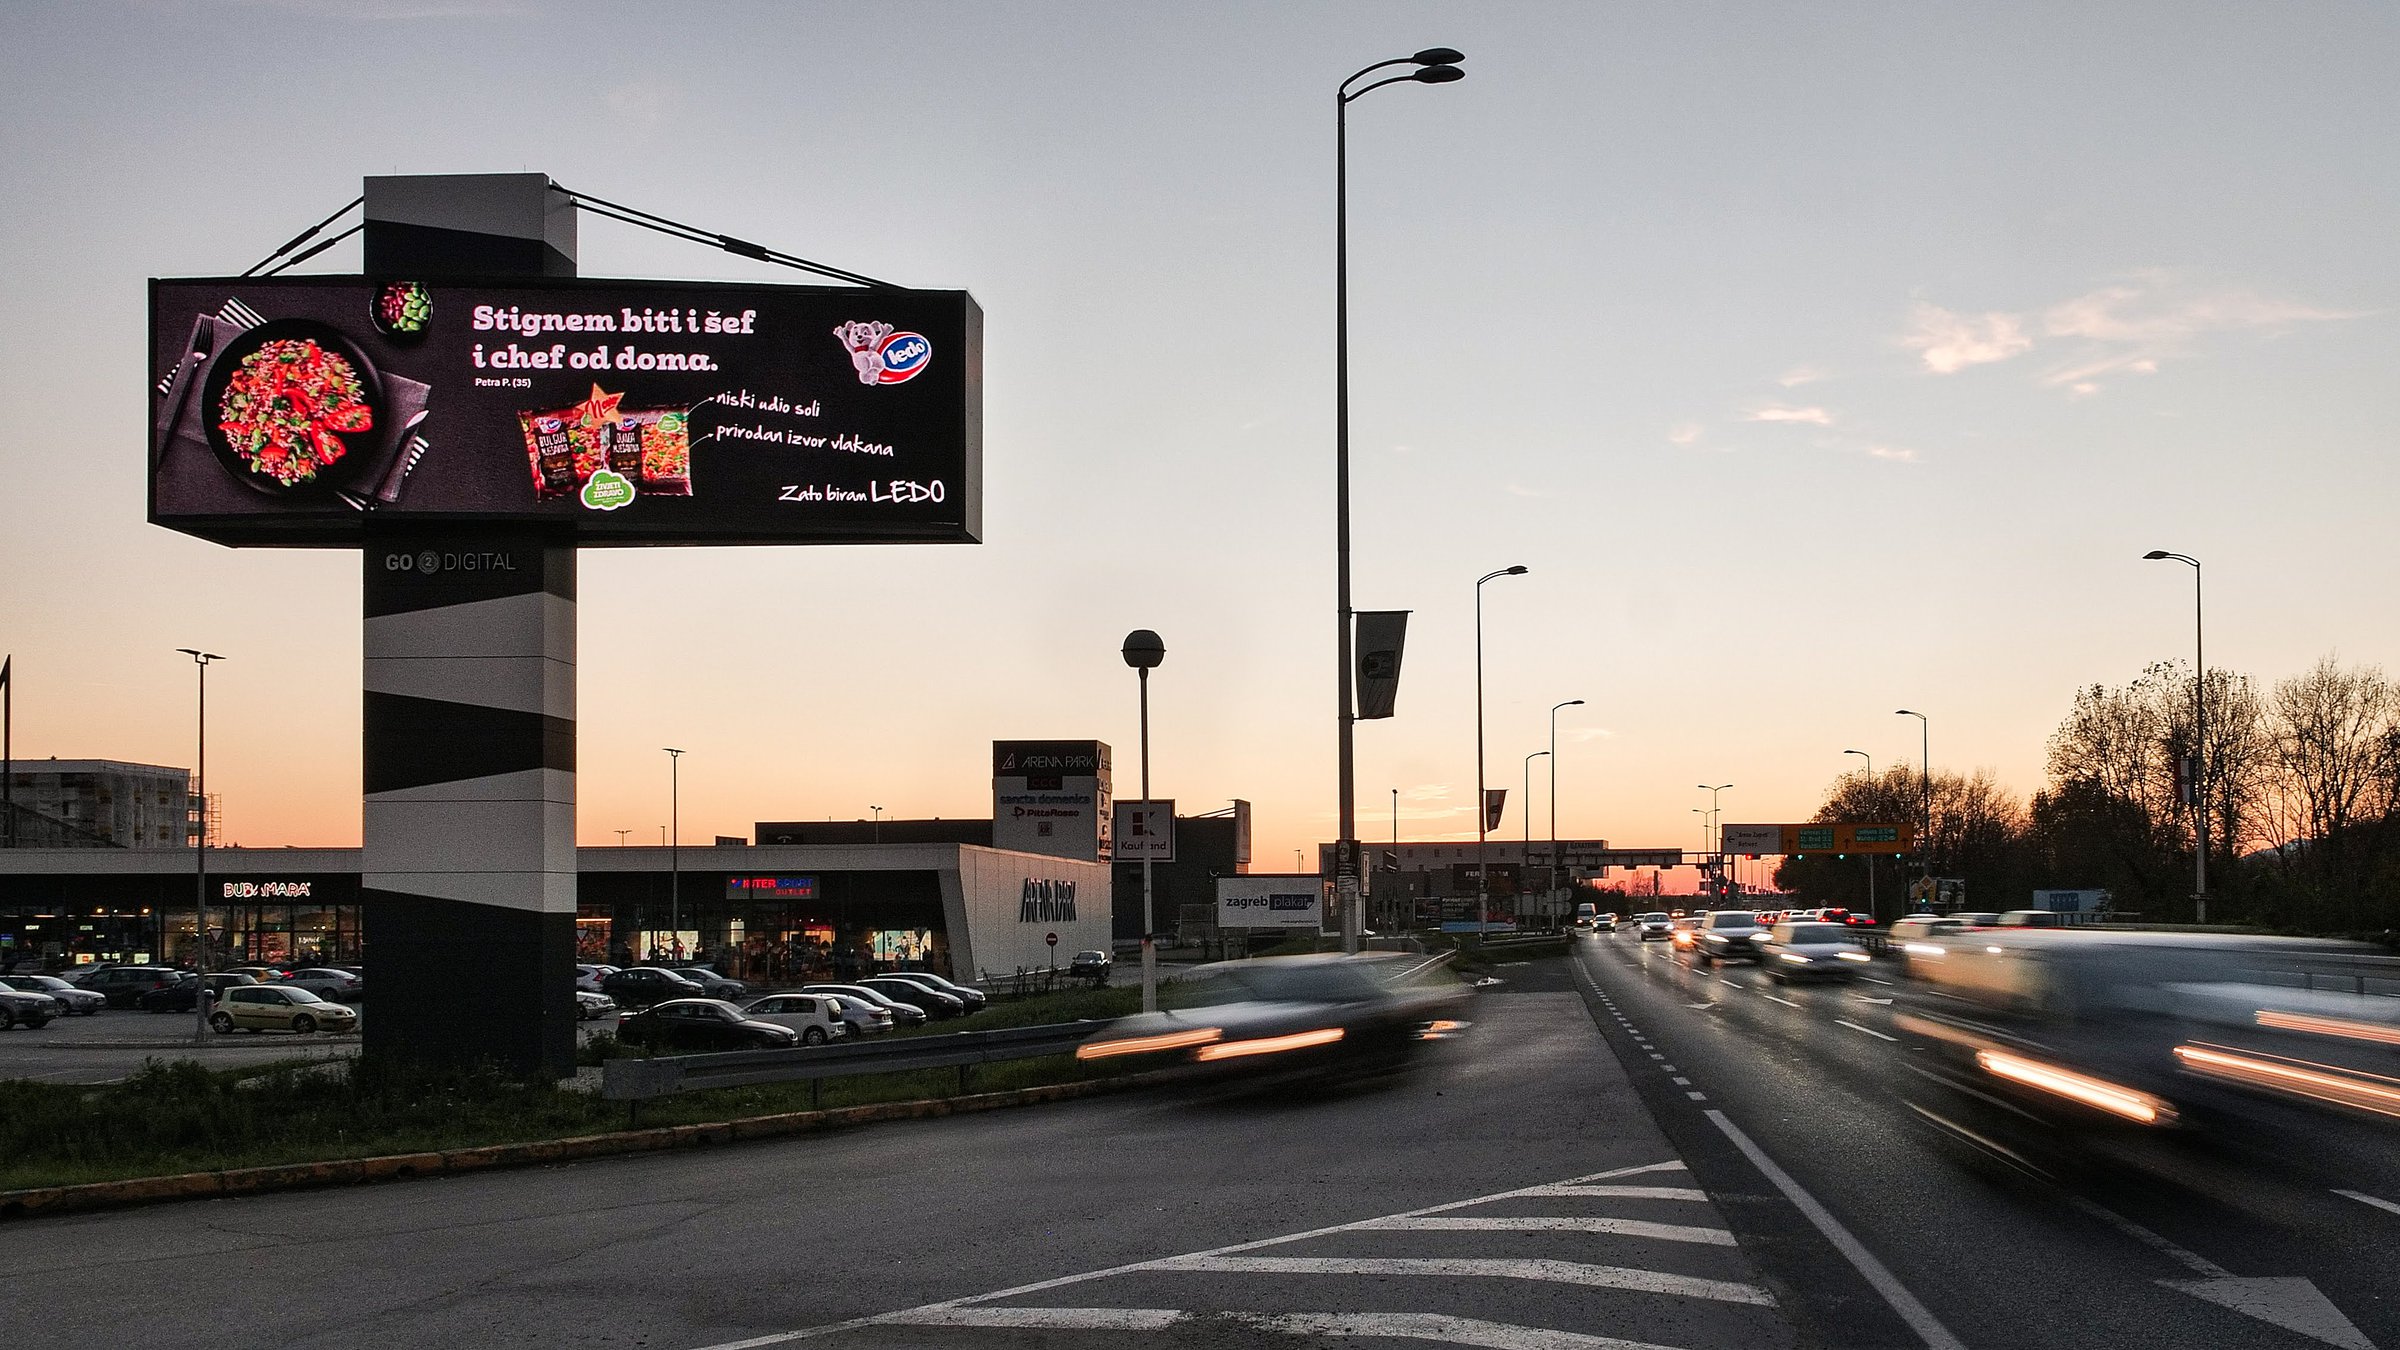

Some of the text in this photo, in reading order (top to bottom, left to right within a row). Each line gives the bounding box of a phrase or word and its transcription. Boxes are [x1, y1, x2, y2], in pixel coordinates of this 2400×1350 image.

[473, 305, 757, 337] Stignem biti i šef
[473, 344, 719, 372] i chef od doma.
[886, 340, 926, 366] ledo
[475, 377, 531, 389] Petra P. (35)
[716, 389, 821, 418] niski udio soli
[716, 423, 894, 457] prirodan izvor vlakana
[593, 489, 624, 498] ZDRAVO
[778, 479, 946, 504] Zato biram LEDO
[385, 553, 413, 571] GO
[444, 553, 517, 571] DIGITAL
[1021, 755, 1094, 768] ARENA PARK
[1121, 840, 1167, 850] Kaufand
[1226, 895, 1308, 909] zagreb plakat
